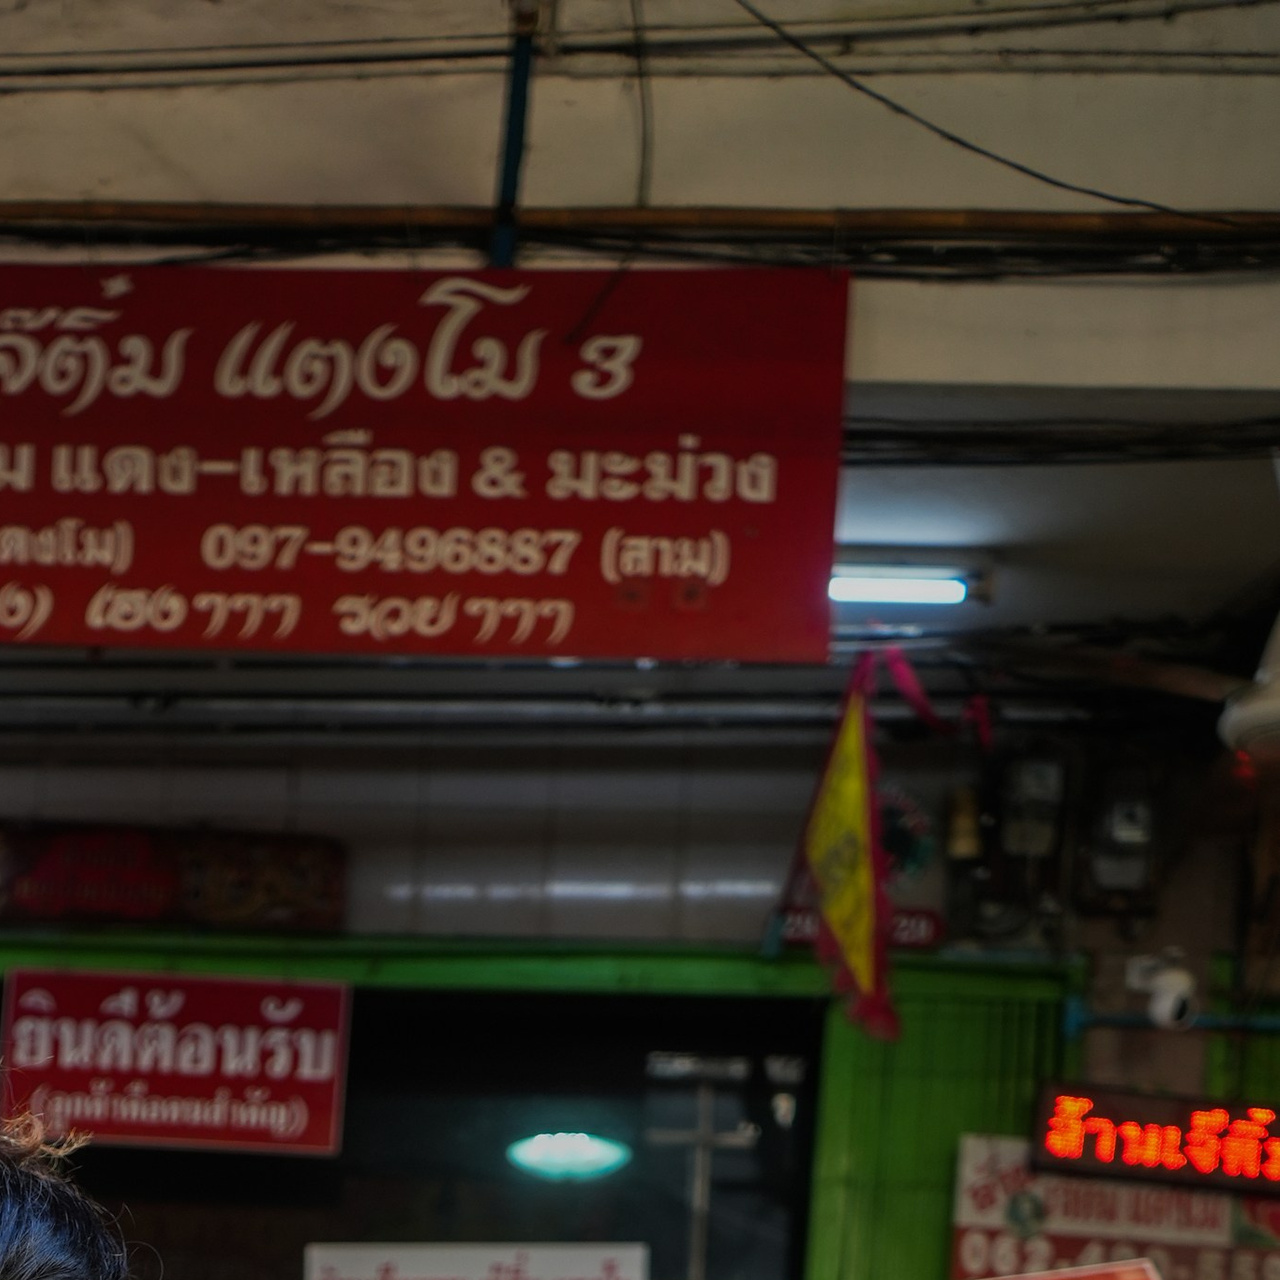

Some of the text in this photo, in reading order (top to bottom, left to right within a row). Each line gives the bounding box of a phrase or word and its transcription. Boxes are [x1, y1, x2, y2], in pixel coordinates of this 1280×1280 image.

[214, 276, 549, 419] แตงโม
[571, 333, 643, 399] 3
[471, 446, 529, 497] &
[547, 433, 778, 502] มะม่วง
[201, 523, 581, 575] 097-9496887
[601, 527, 730, 585] (สาม)
[11, 985, 336, 1082] ยินดีต้อนรับ
